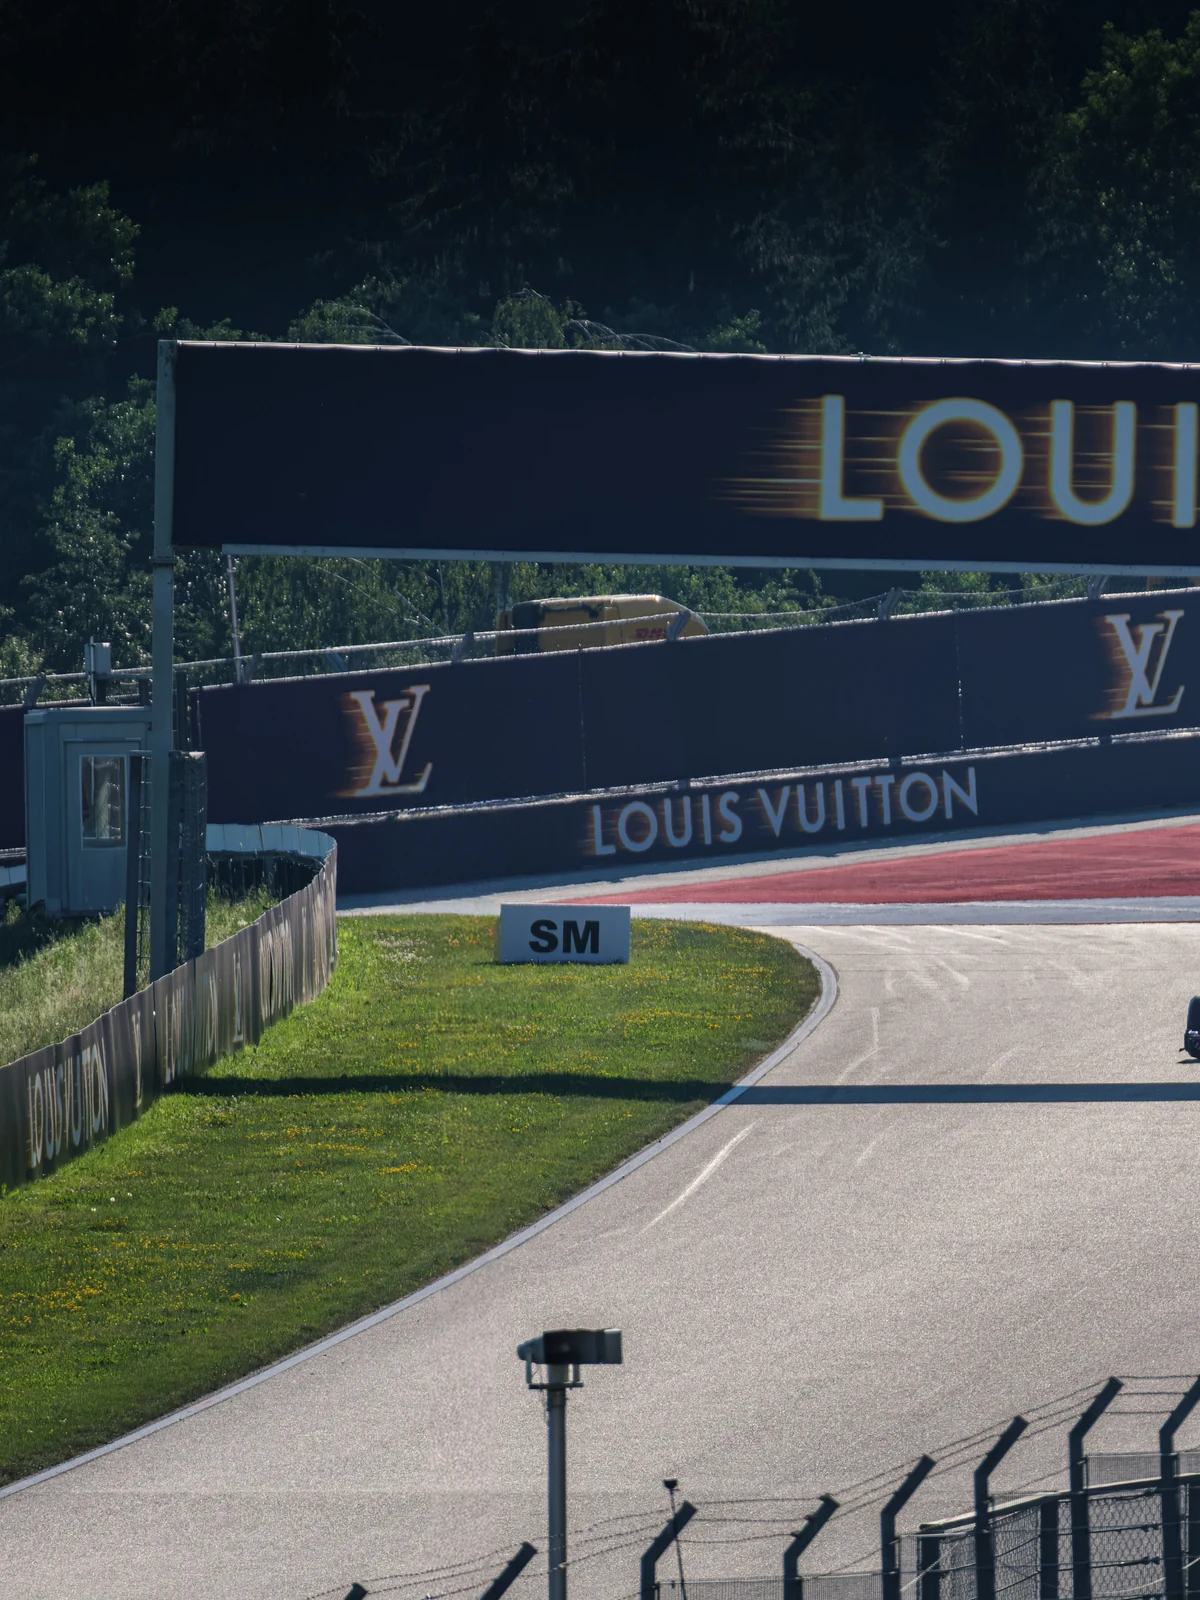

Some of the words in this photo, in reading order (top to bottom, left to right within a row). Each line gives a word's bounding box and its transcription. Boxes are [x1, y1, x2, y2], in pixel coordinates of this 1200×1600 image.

[592, 791, 743, 855] LOUIS
[757, 767, 979, 837] VUITTON
[528, 919, 600, 954] SM
